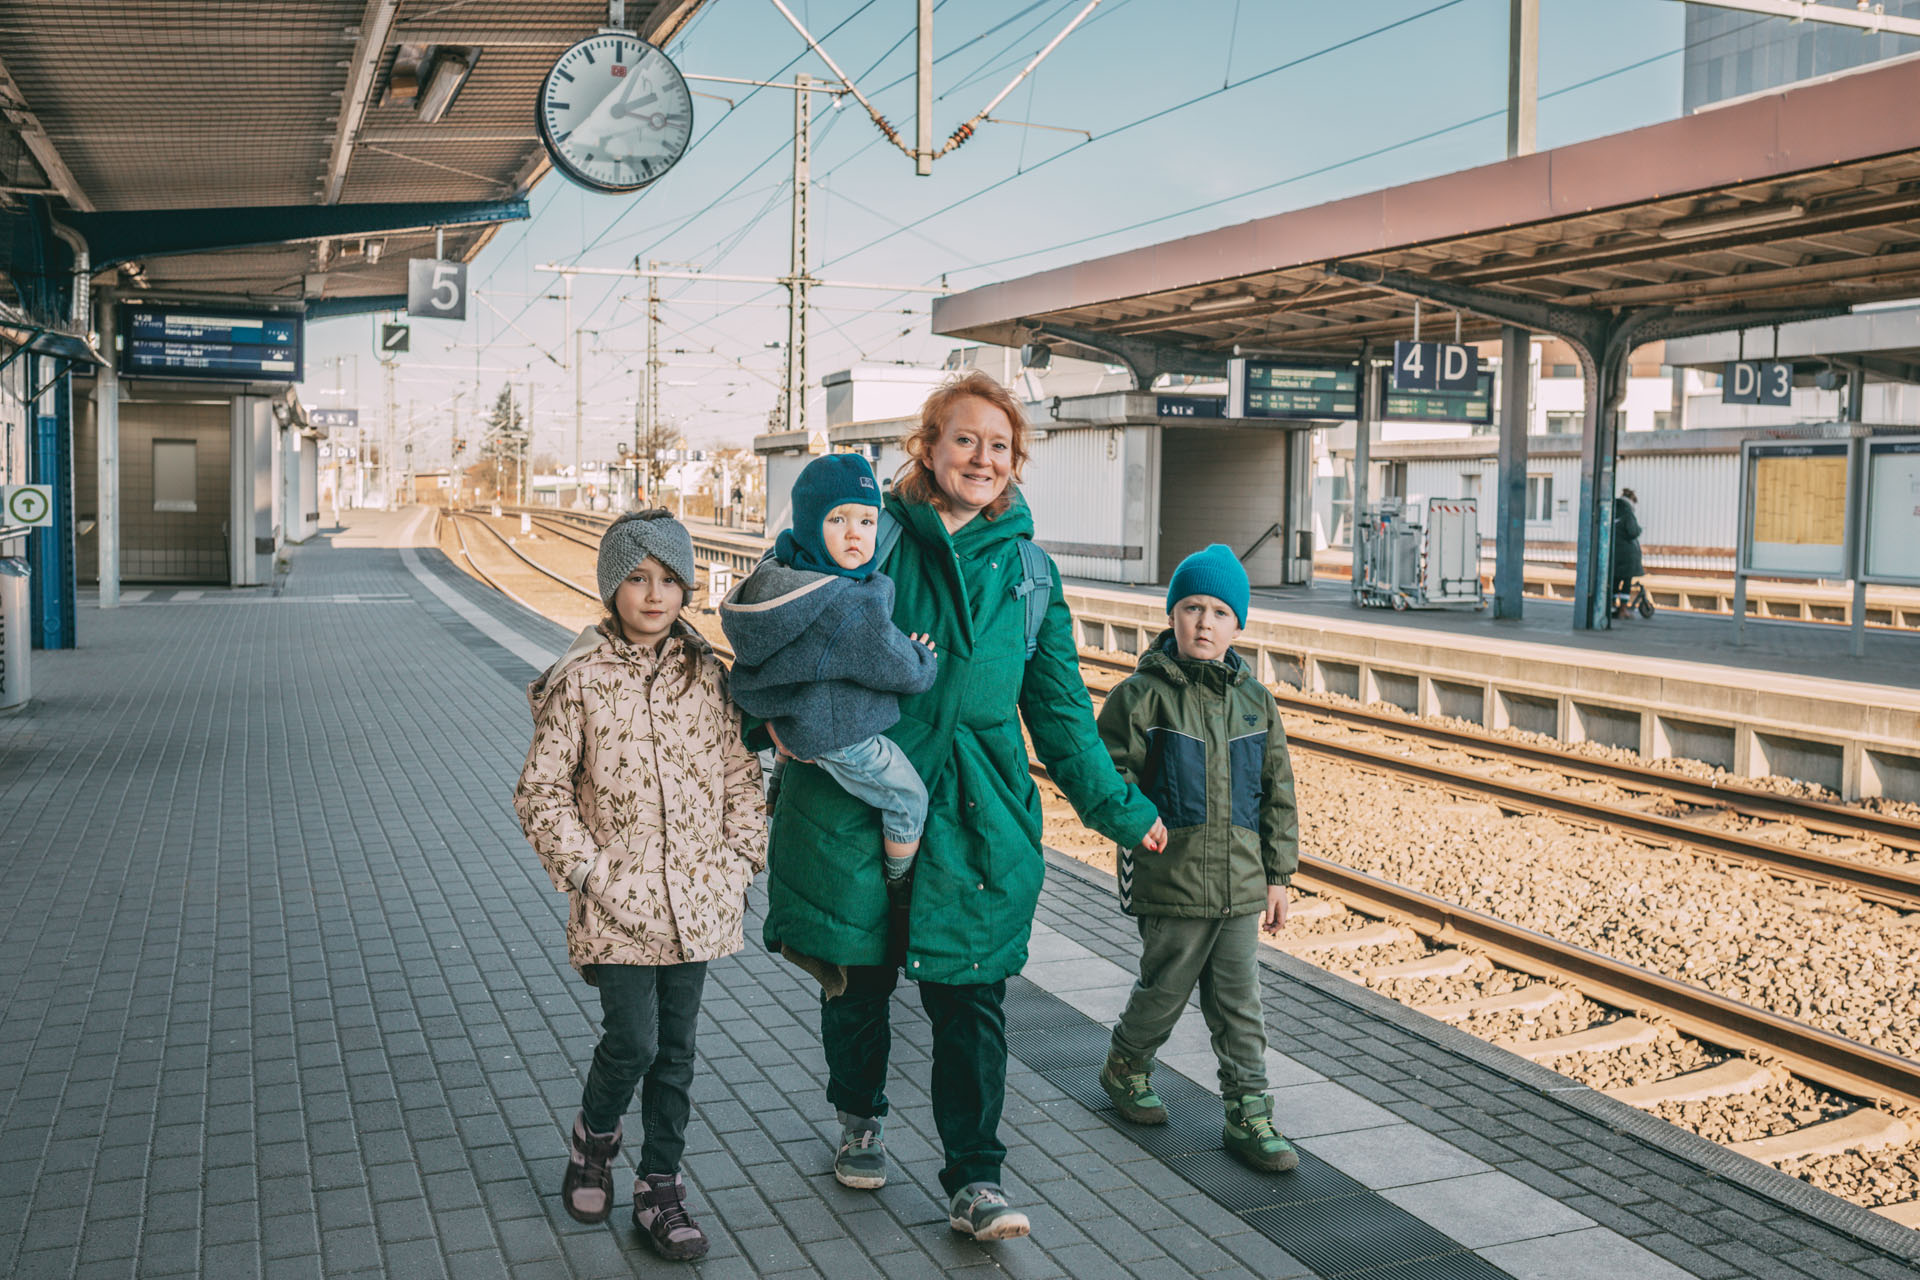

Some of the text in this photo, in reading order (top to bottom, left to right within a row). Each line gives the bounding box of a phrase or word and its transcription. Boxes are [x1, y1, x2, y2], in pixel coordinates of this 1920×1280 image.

[430, 266, 460, 311] 5
[1402, 343, 1469, 381] 4 D
[1734, 363, 1789, 398] D 3
[715, 575, 727, 593] H
